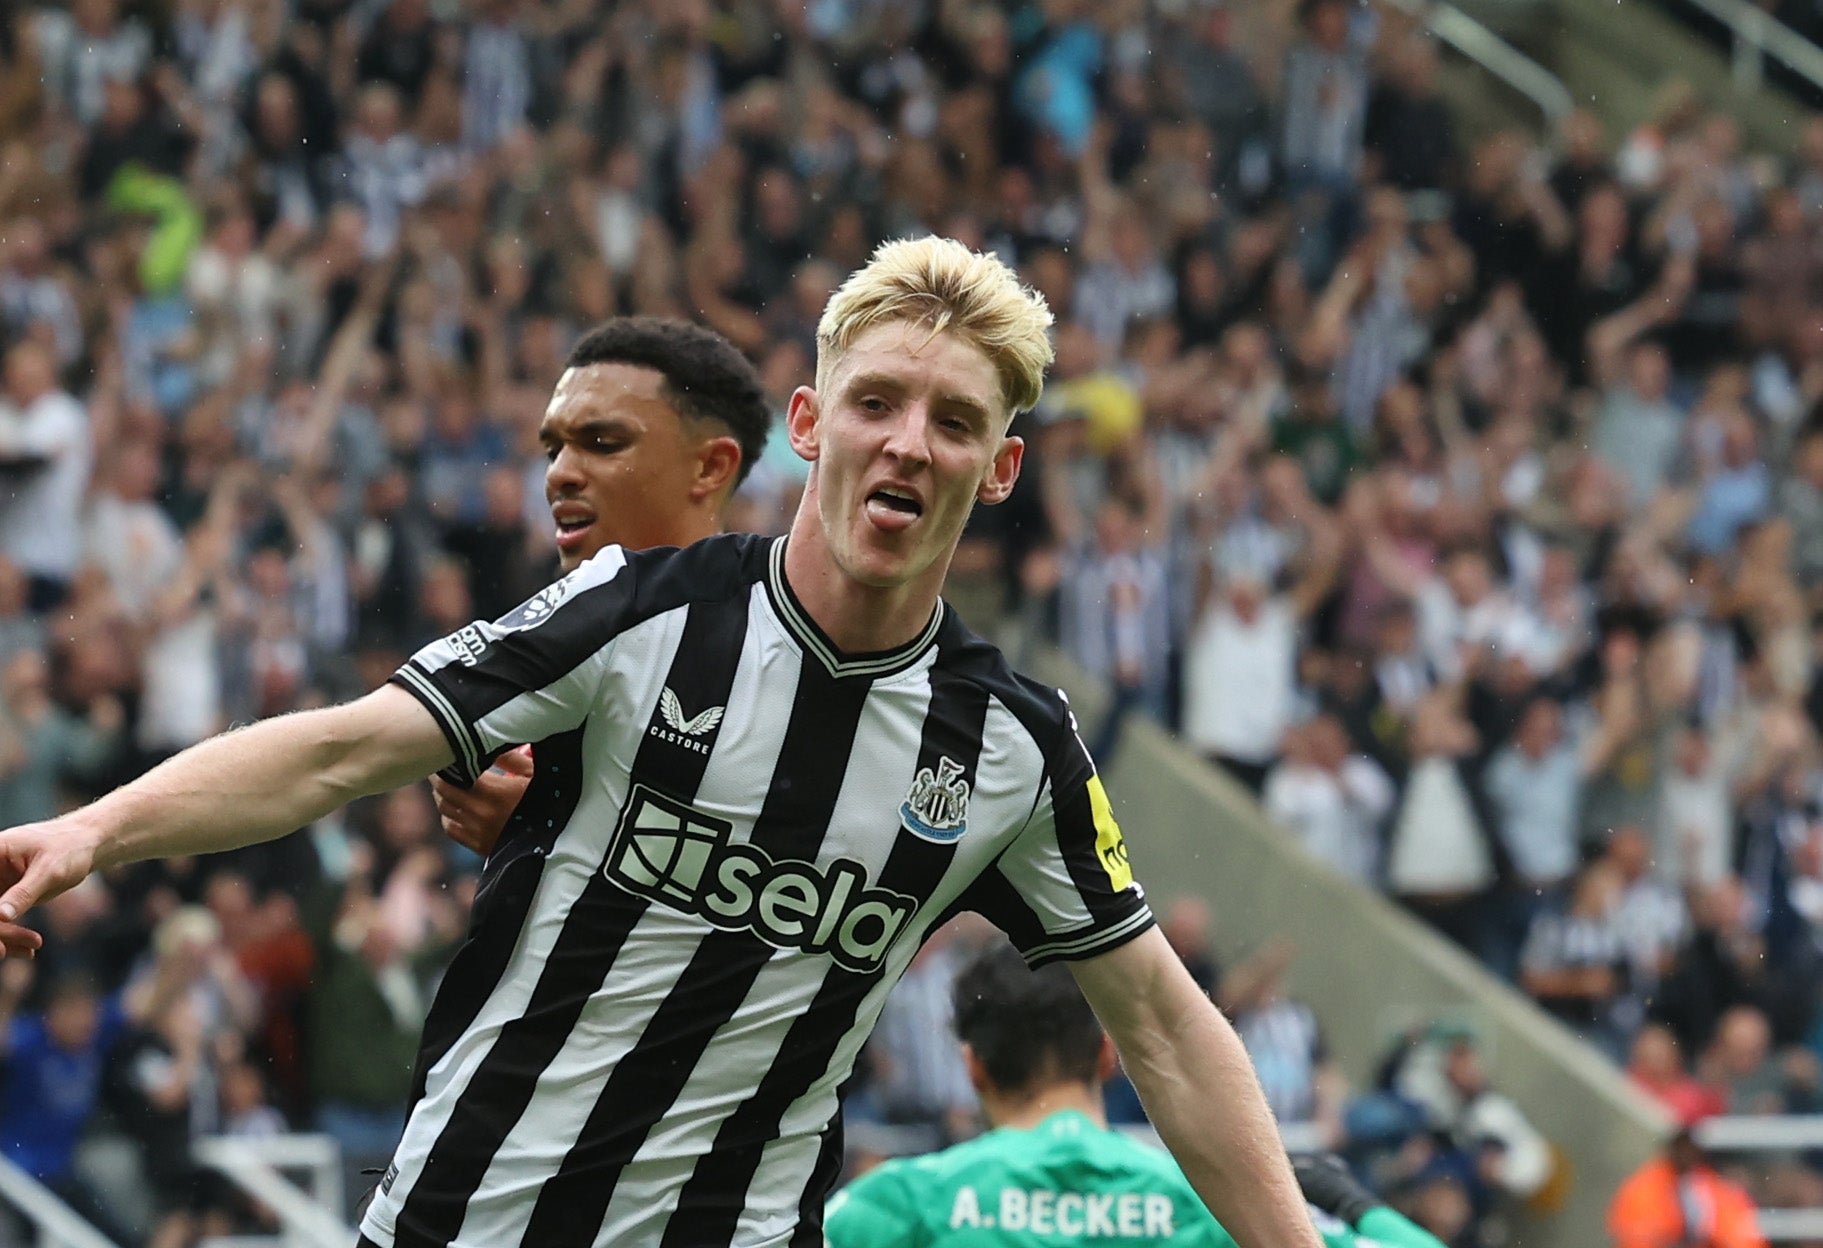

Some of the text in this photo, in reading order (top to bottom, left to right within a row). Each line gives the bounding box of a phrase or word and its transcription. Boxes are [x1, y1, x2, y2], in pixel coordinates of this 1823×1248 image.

[650, 726, 710, 755] CASTORE
[704, 855, 907, 963] sela
[950, 1185, 1175, 1238] A.BECKER
